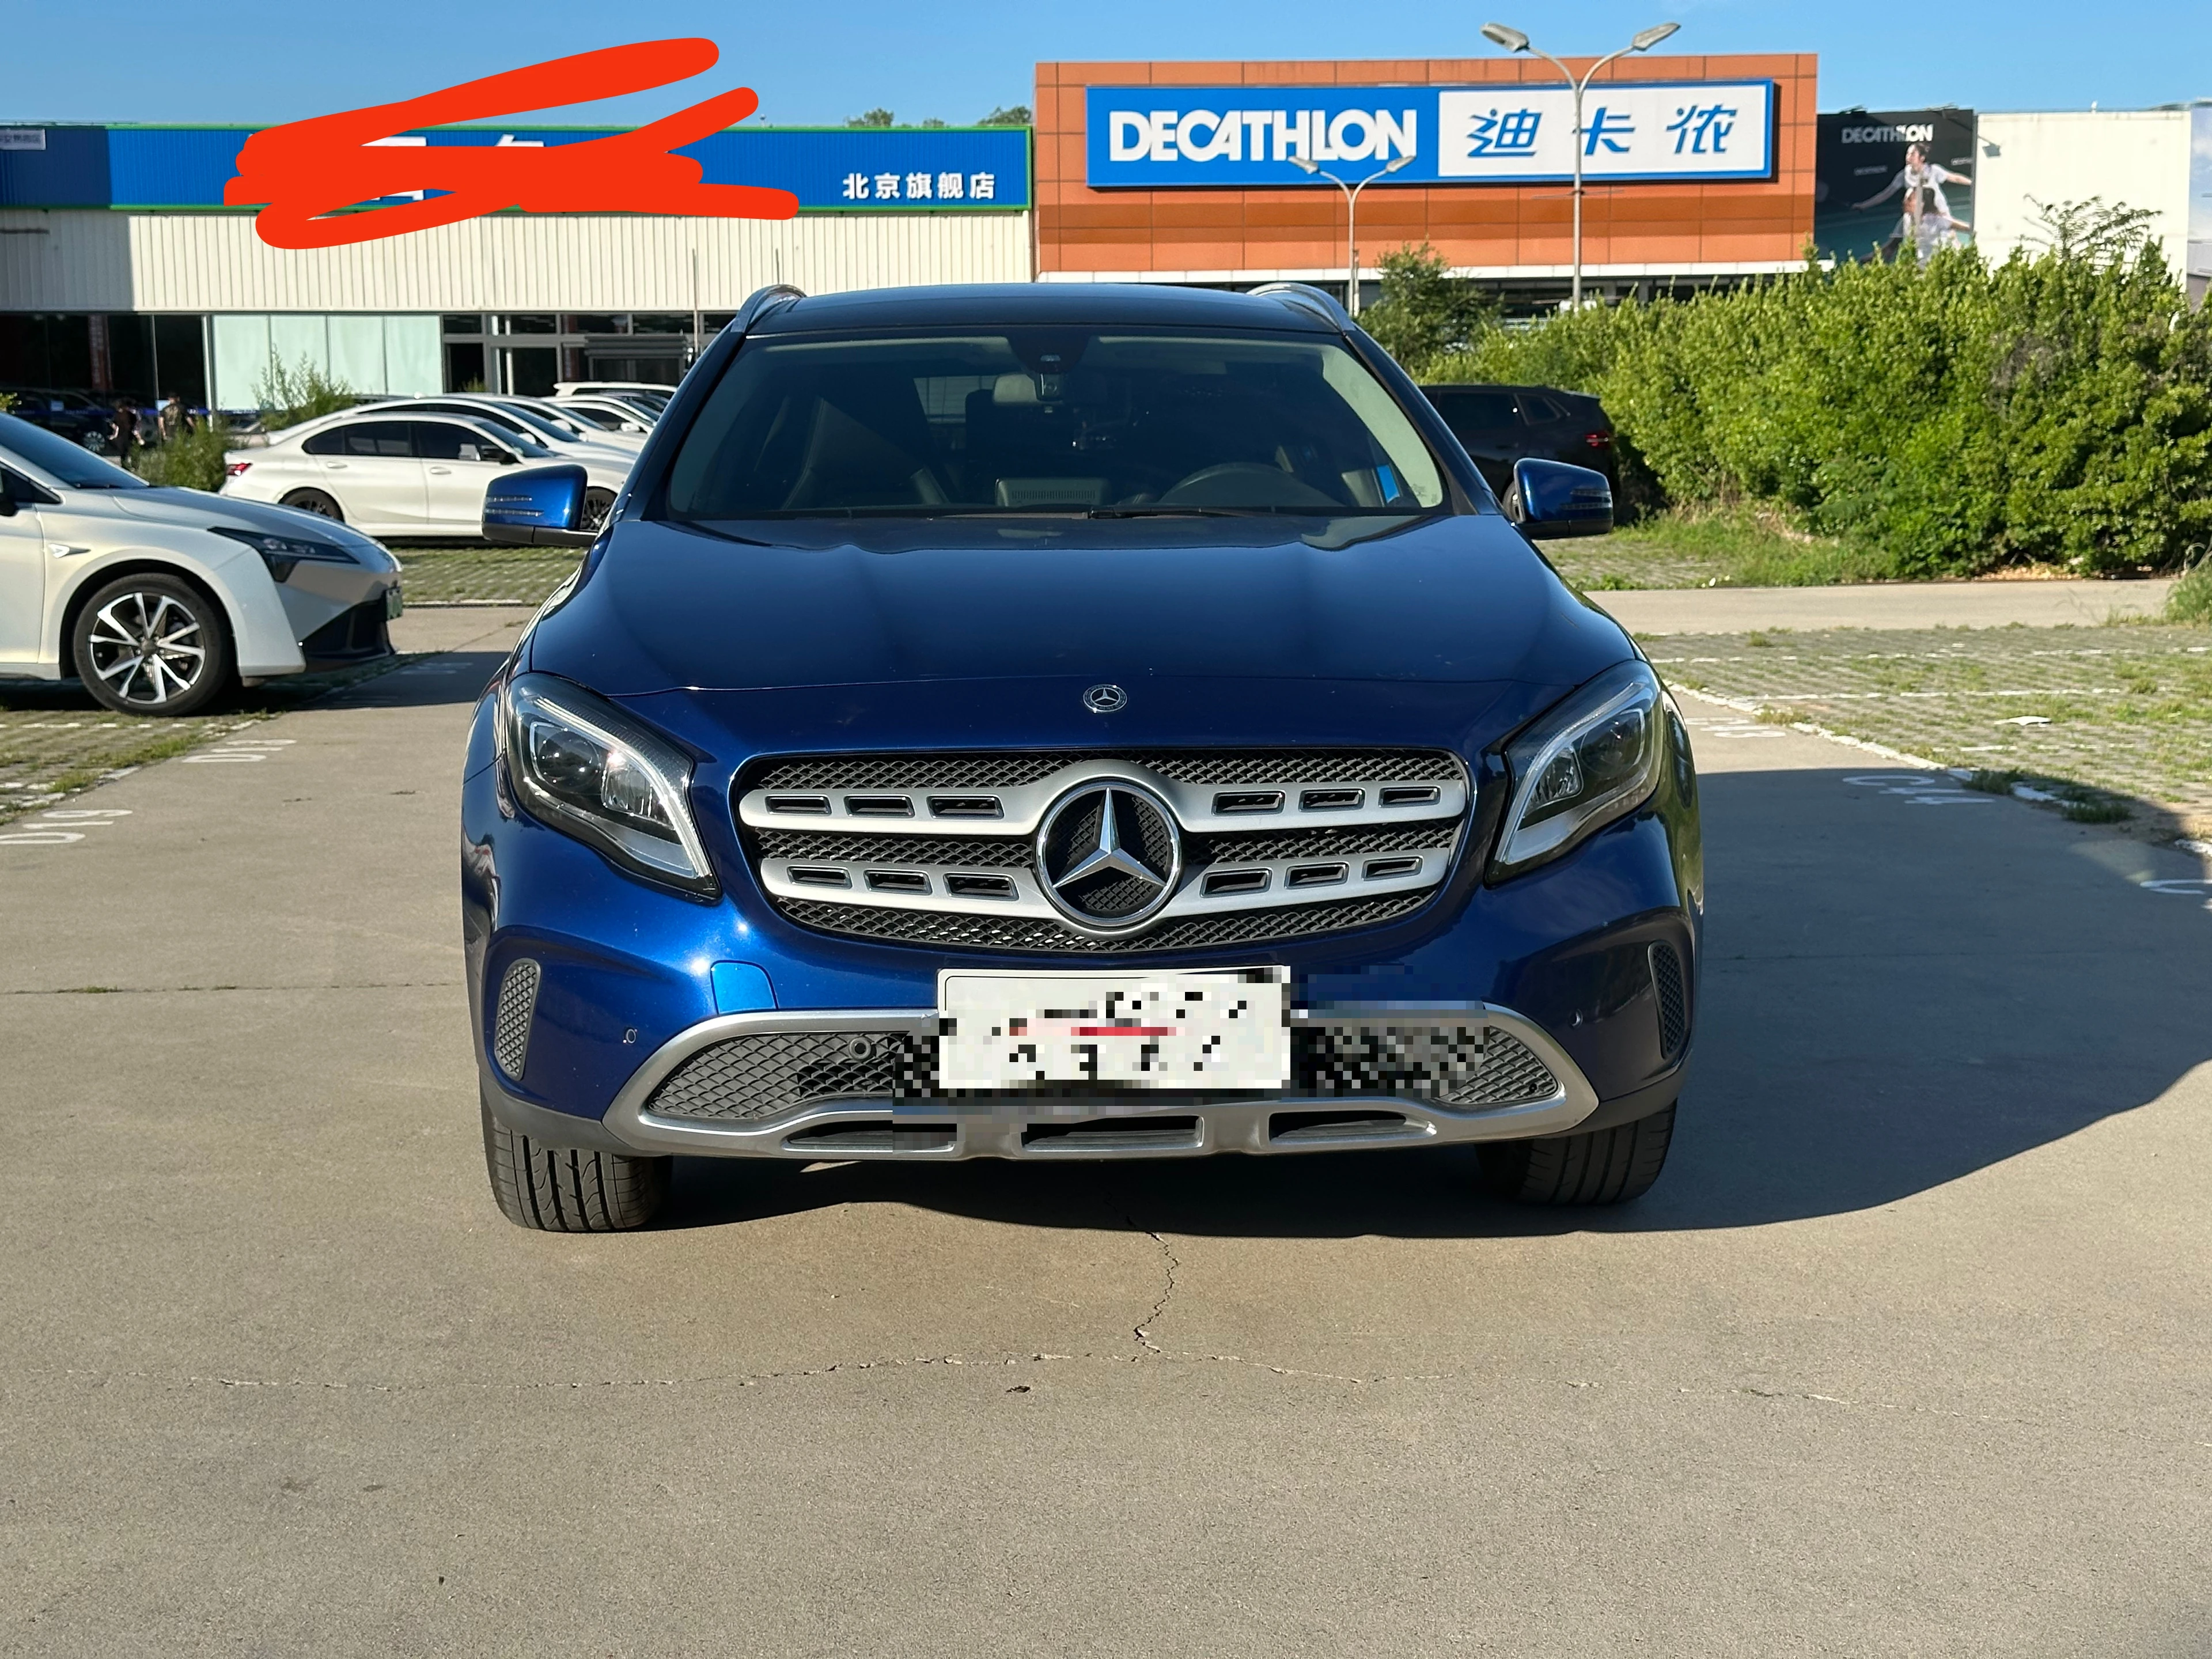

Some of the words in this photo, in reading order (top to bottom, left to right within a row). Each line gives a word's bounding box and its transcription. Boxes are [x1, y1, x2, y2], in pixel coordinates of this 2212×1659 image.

[1109, 109, 1417, 162] DECATHLON
[1466, 104, 1738, 158] 迪卡侬
[1842, 124, 1933, 143] DECATHLON
[842, 172, 995, 200] 北京旗舰店
